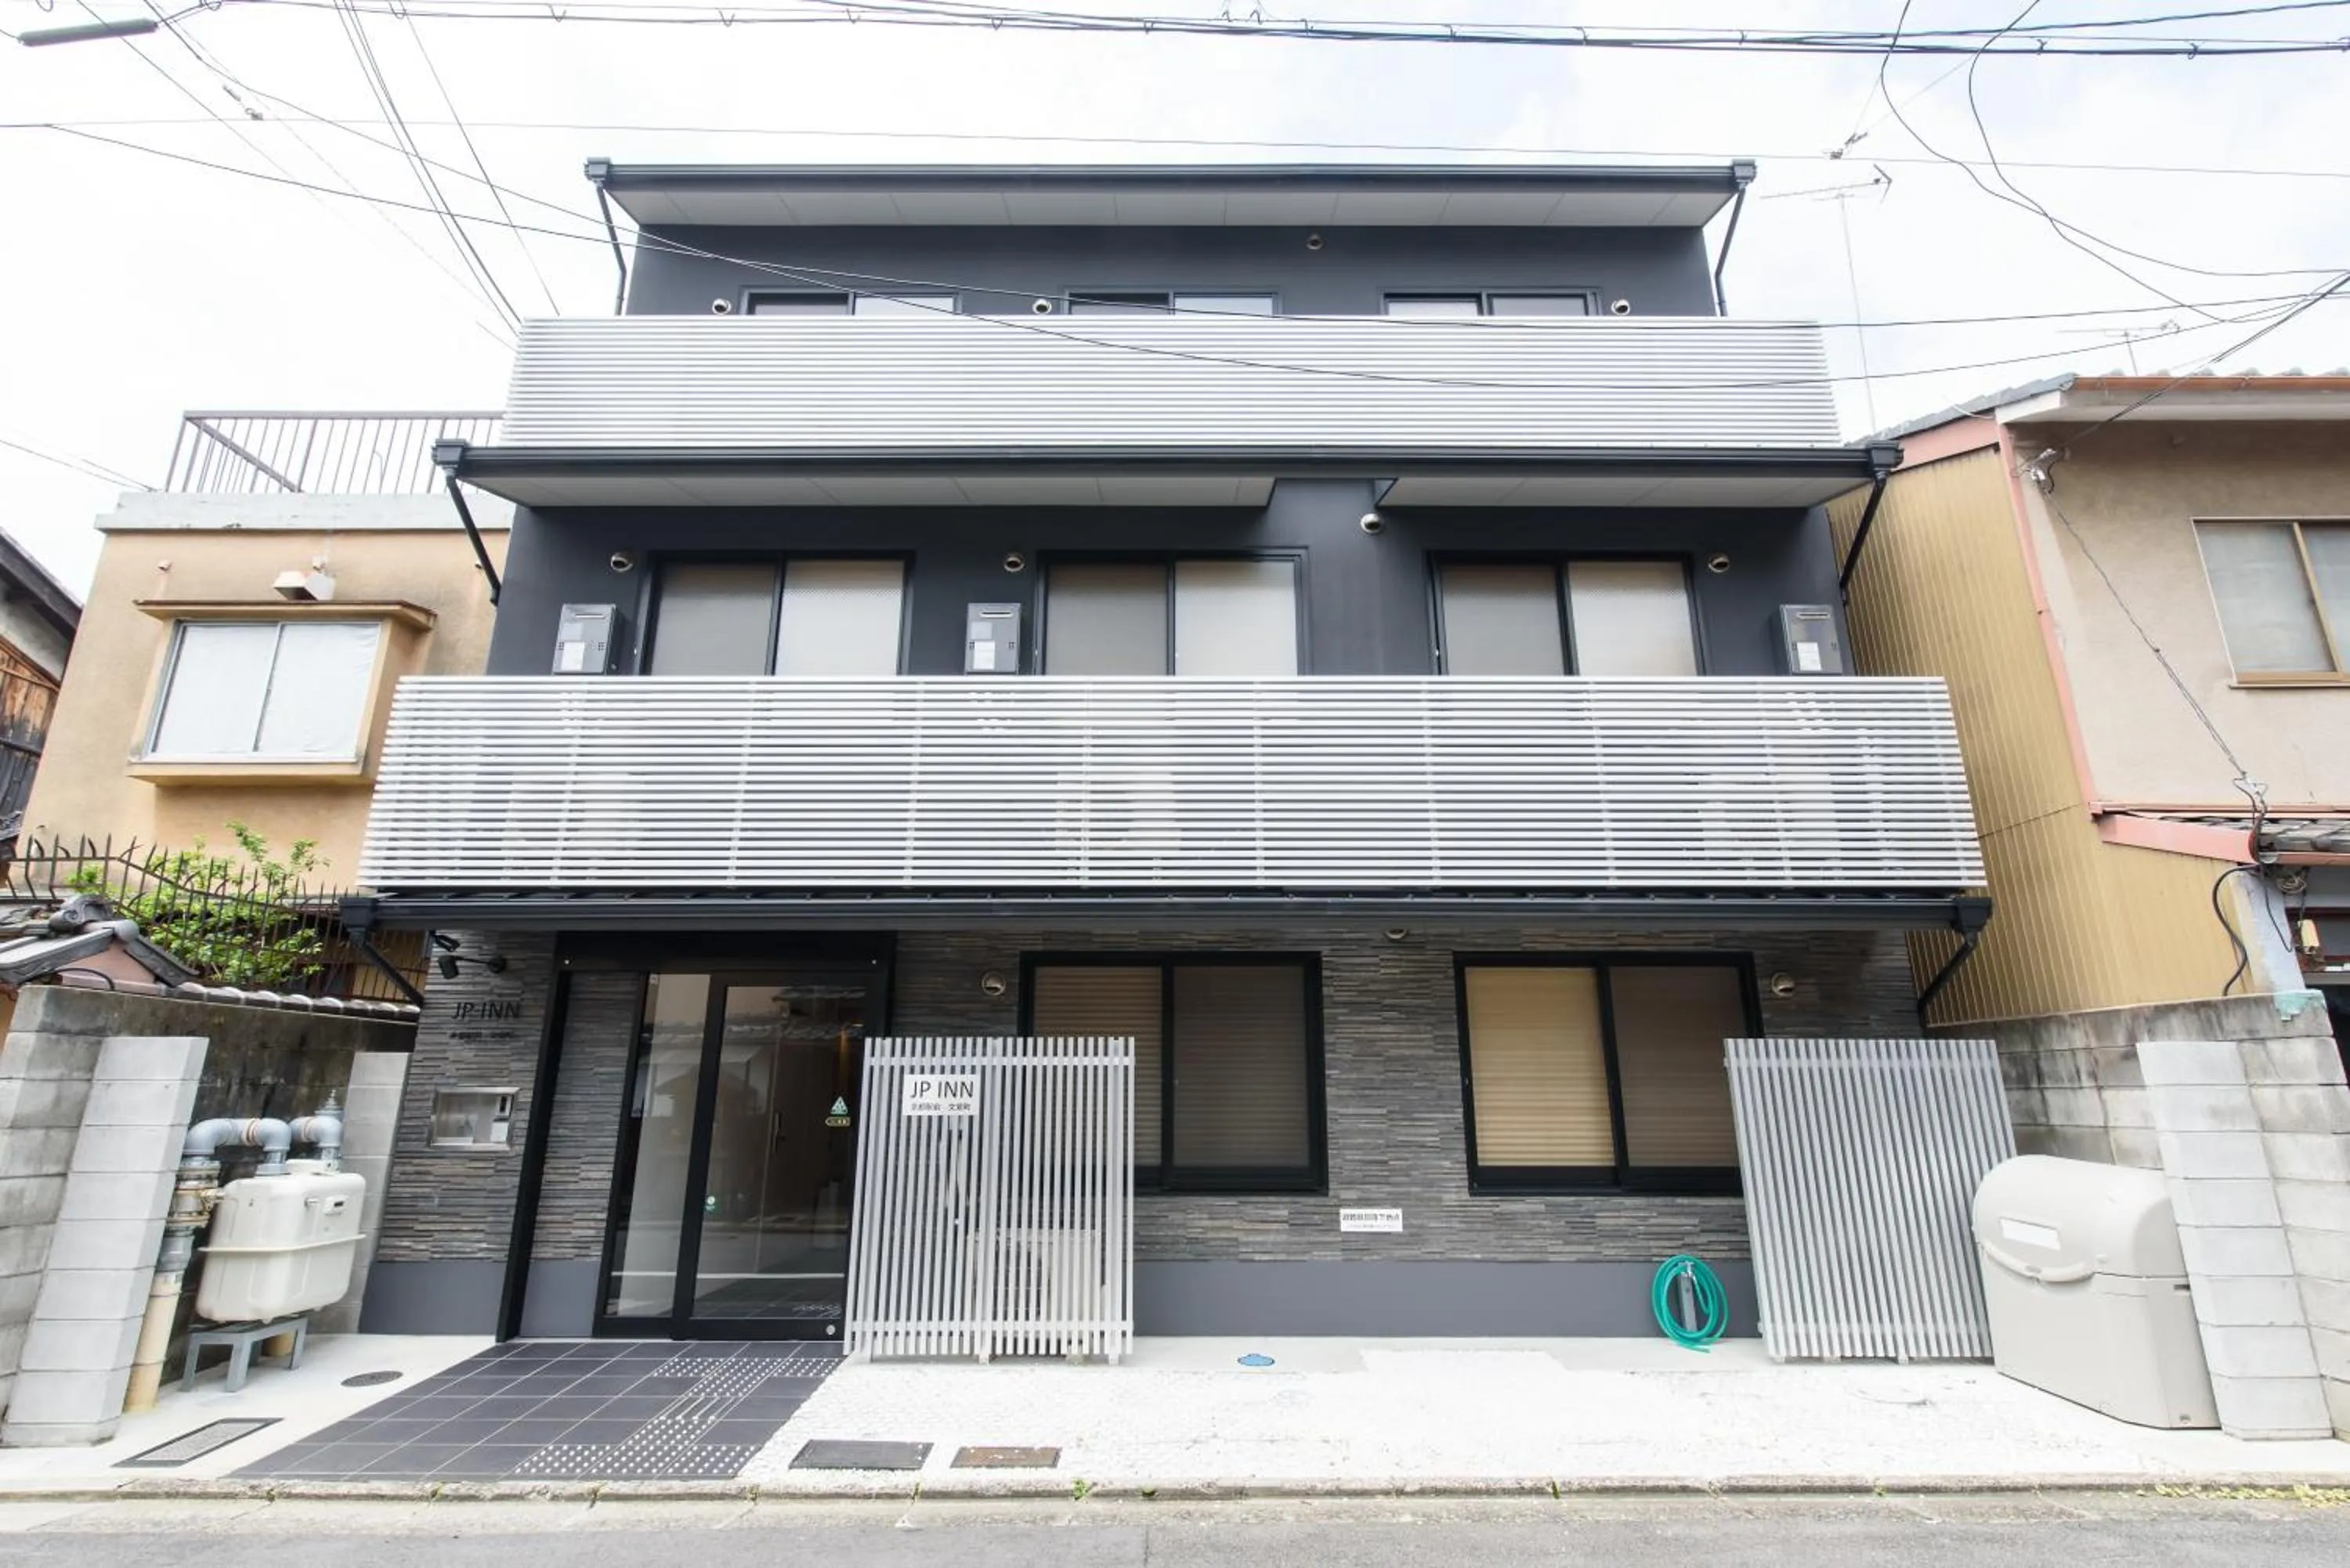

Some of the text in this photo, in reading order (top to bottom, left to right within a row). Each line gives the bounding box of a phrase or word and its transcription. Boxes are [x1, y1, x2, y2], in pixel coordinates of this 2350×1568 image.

[480, 1002, 521, 1020] INN
[910, 1080, 974, 1098] JP INN
